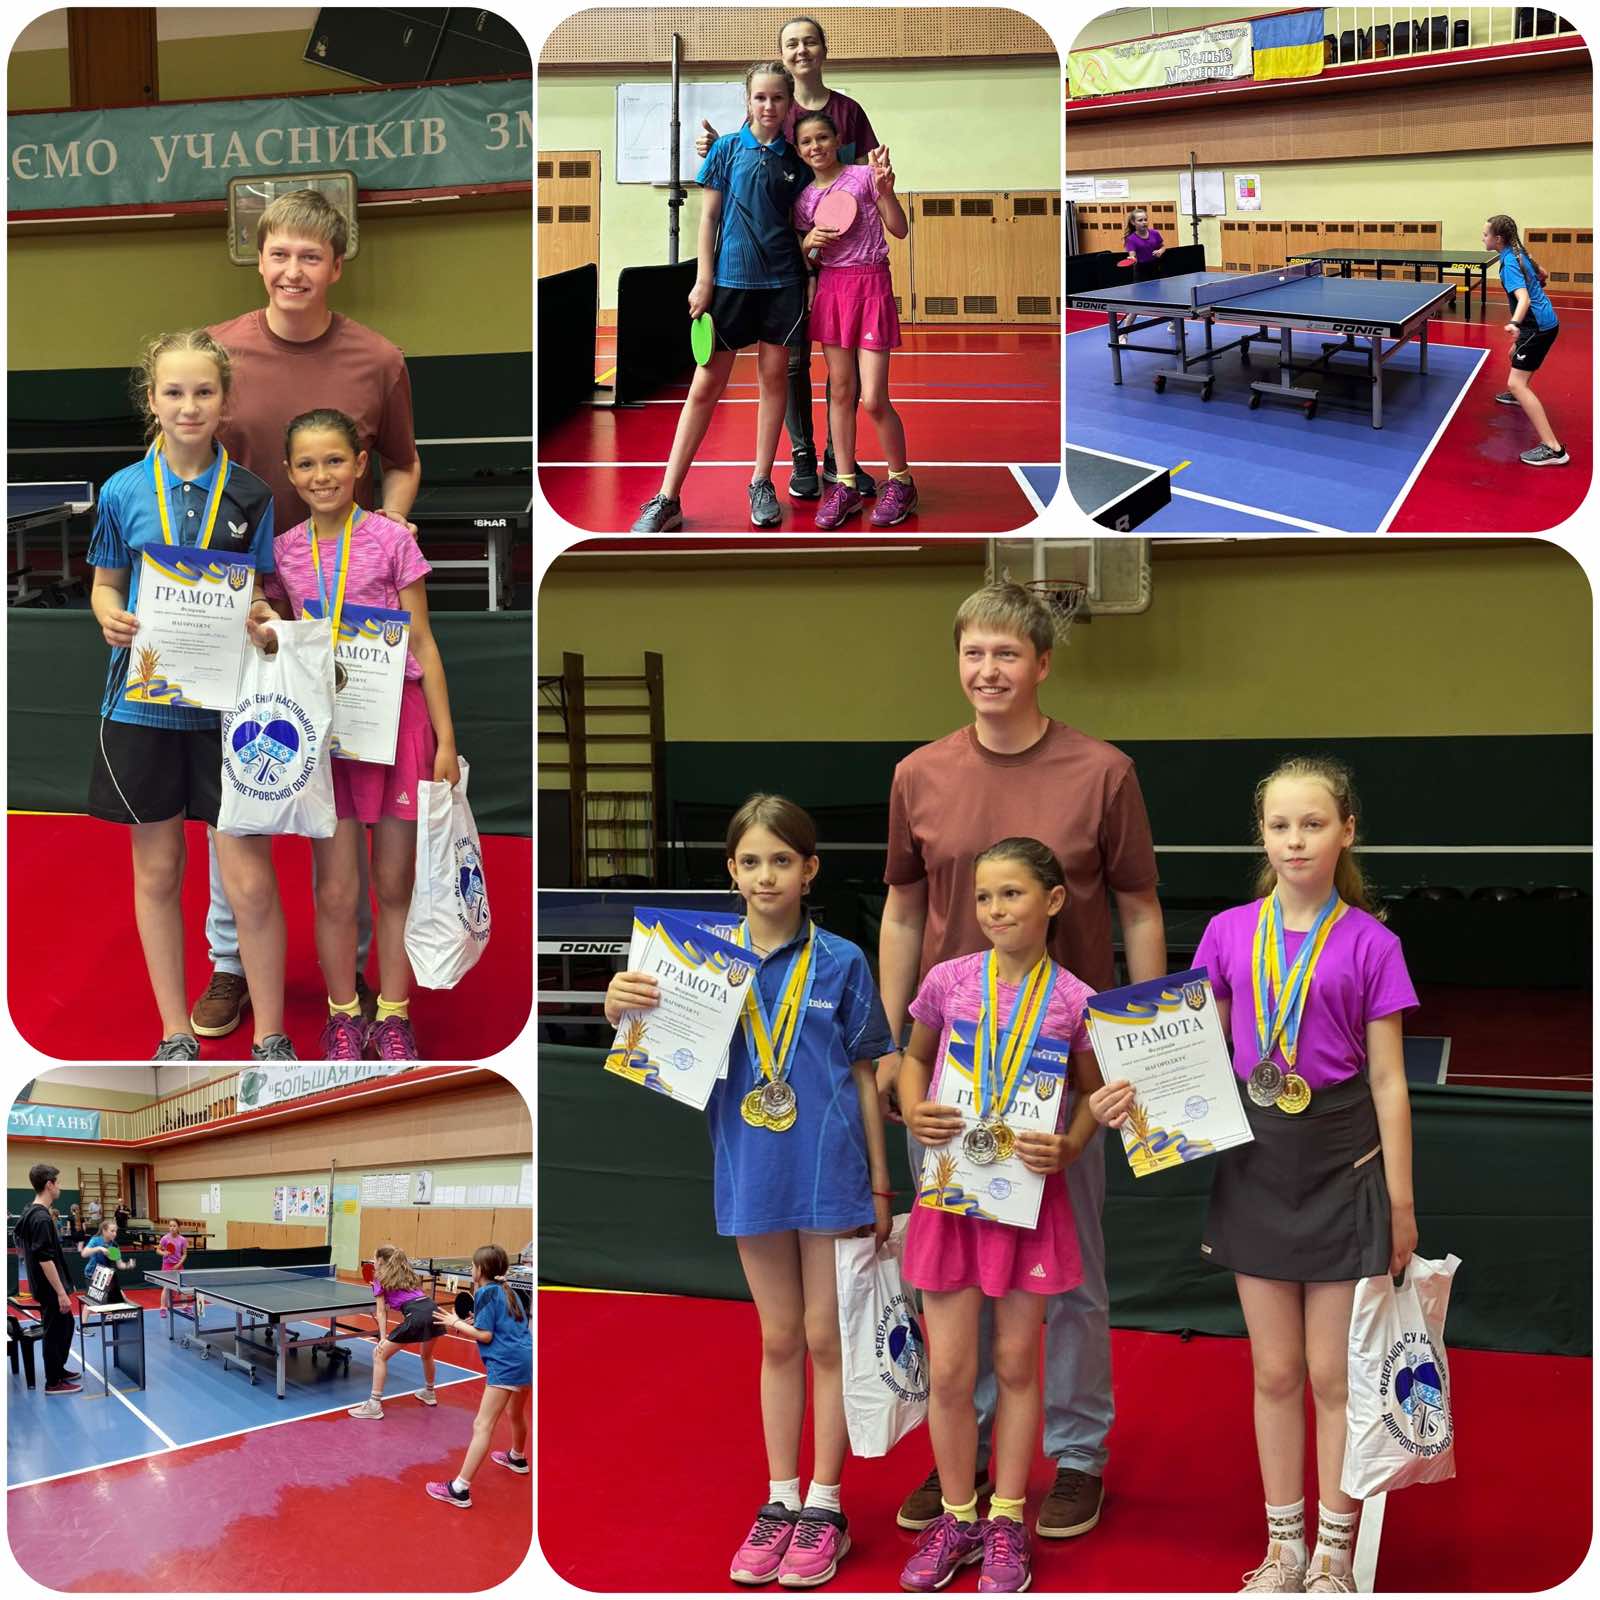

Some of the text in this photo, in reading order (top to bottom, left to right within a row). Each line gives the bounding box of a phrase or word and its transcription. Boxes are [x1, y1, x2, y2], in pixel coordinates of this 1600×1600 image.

[1179, 48, 1232, 68] Белые
[8, 138, 118, 180] ЄМО
[150, 116, 448, 182] УЧАСНИКІВ
[1076, 301, 1107, 310] DONIC
[1332, 323, 1384, 335] DONIC
[155, 586, 235, 608] ГРАМОТА
[334, 645, 391, 664] АМОТА
[276, 693, 318, 742] НАСТІЛЬНОГО
[223, 756, 317, 801] ДНІПРОПЕТРОВСЬКОЇ ОБЛАСТІ
[559, 943, 623, 953] DONIC
[656, 959, 729, 1004] ГРАМОТА
[1114, 1016, 1204, 1051] ГРАМОТА
[106, 1311, 138, 1320] DONIC
[875, 1305, 894, 1358] ФЕДЕРАЦІЯ
[1379, 1341, 1405, 1396] ФЕДЕРАЦІЯ
